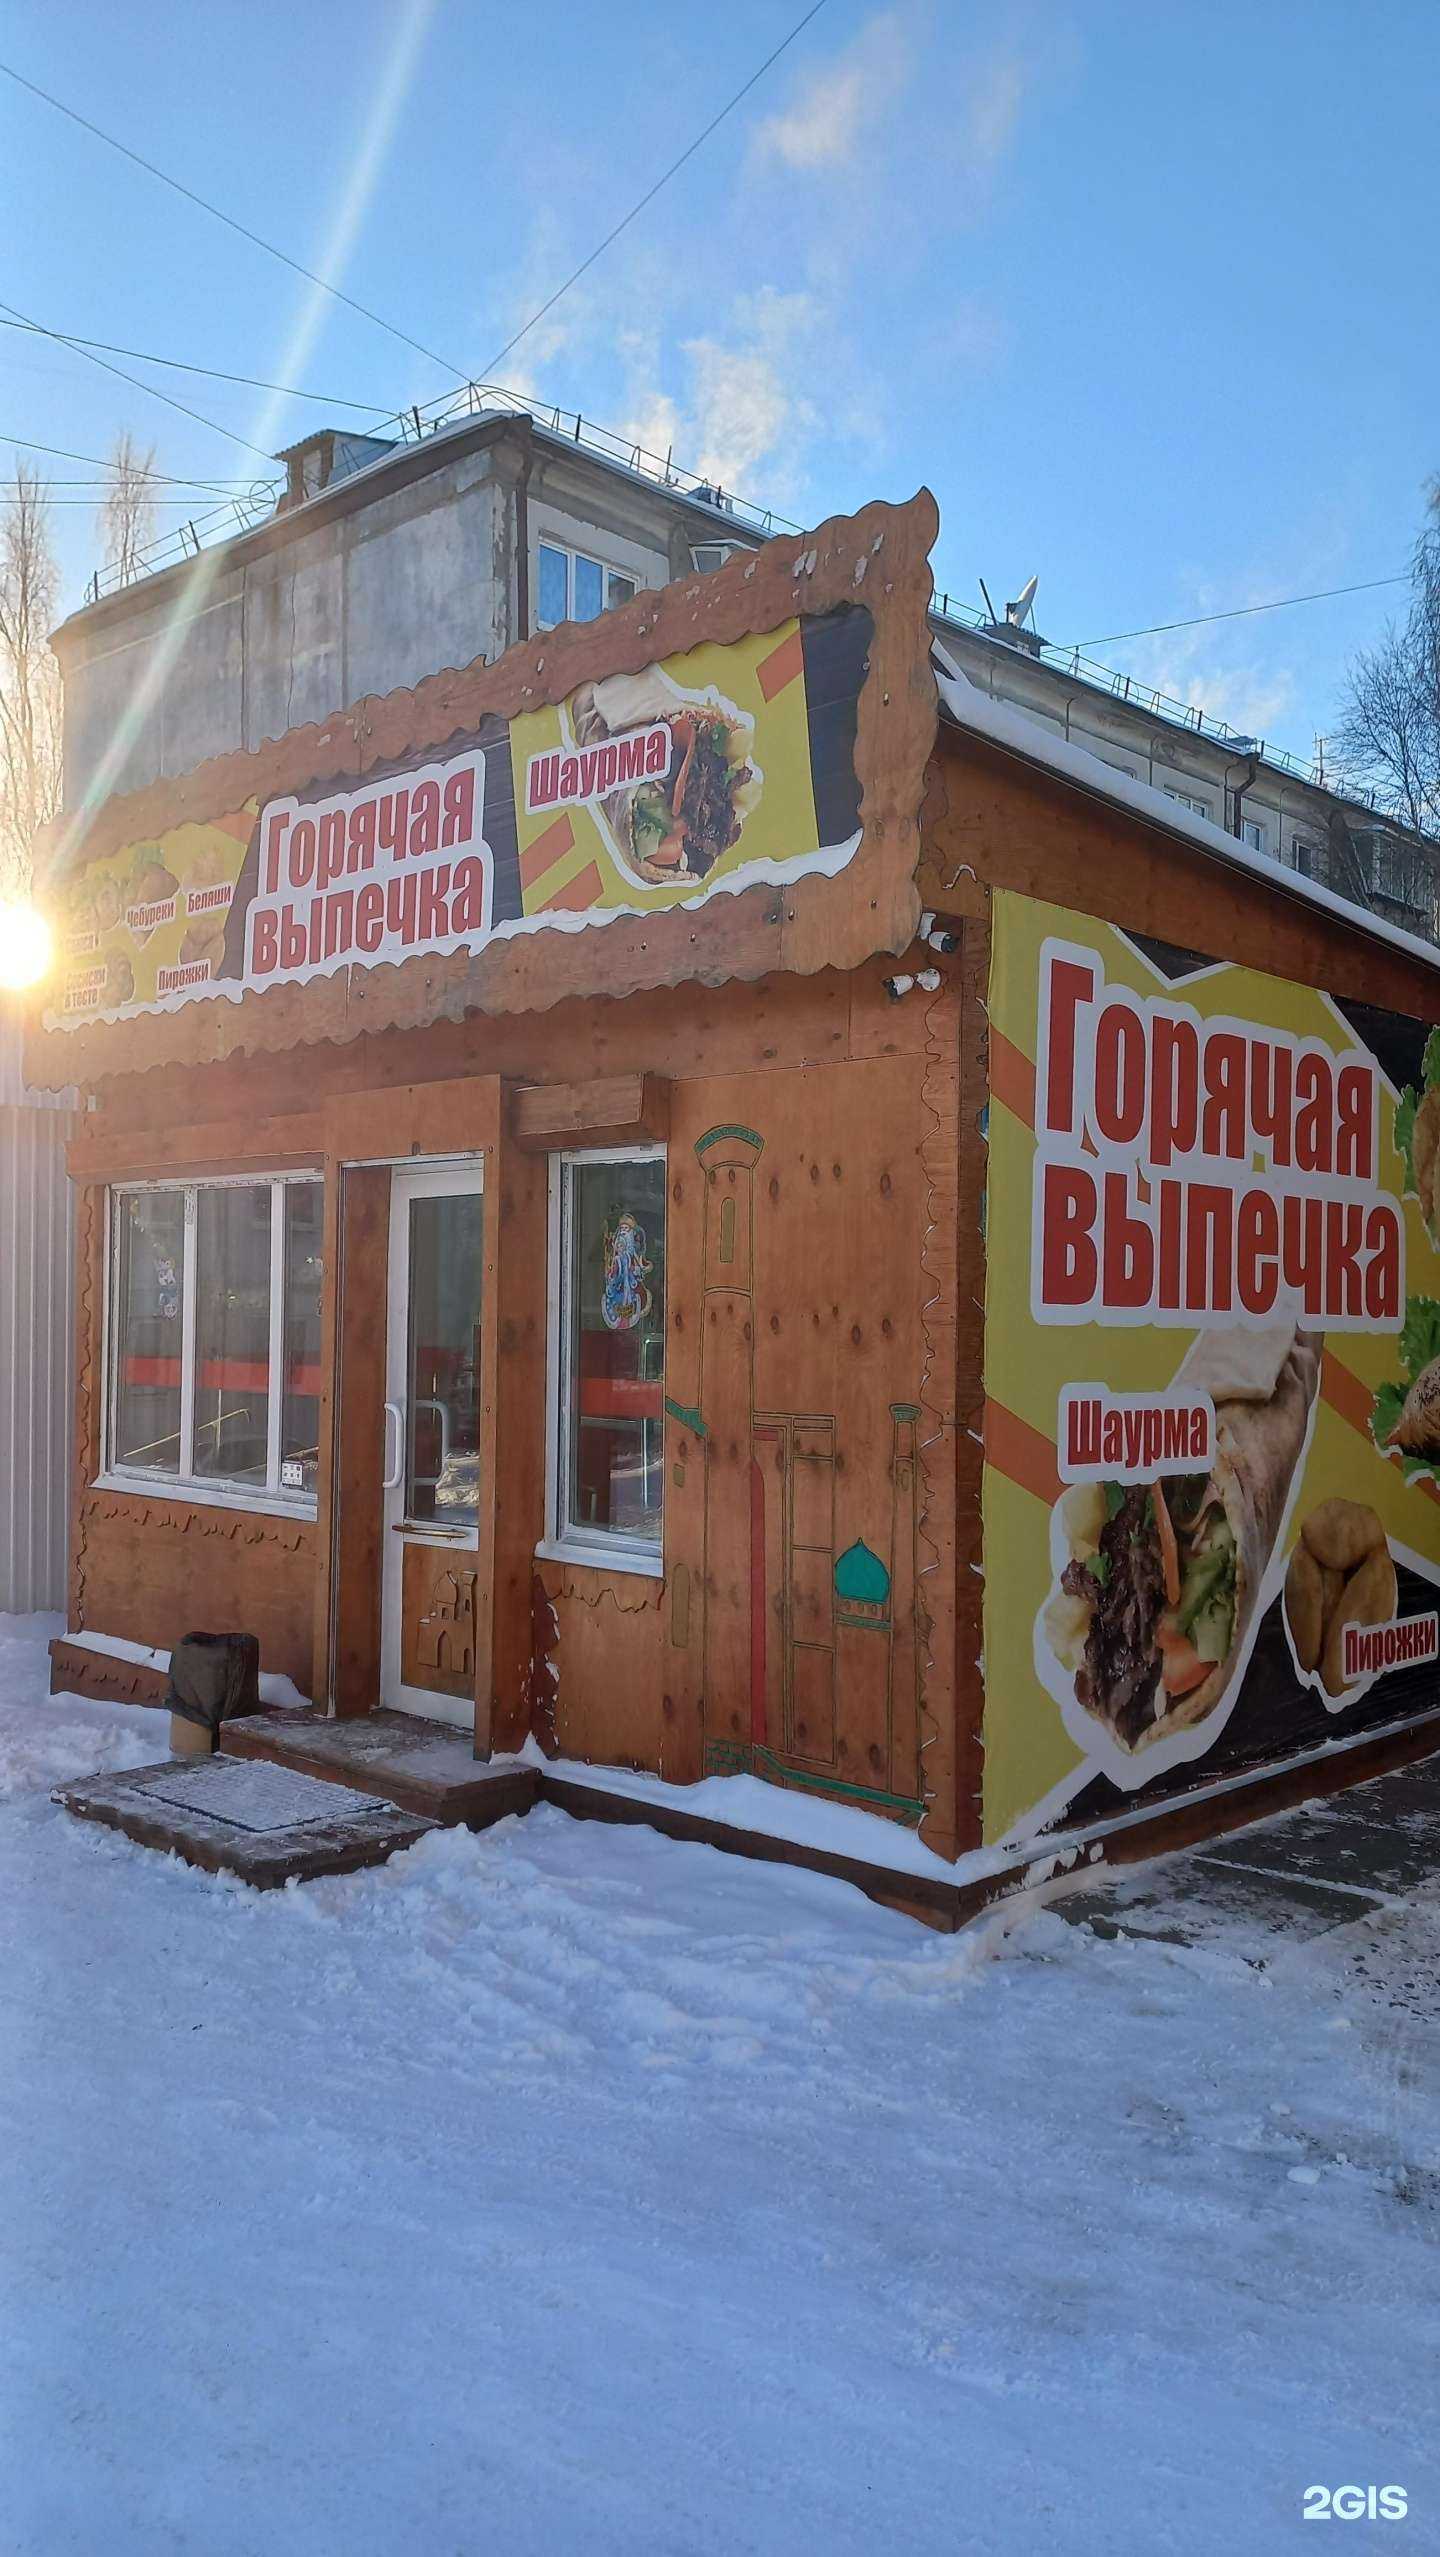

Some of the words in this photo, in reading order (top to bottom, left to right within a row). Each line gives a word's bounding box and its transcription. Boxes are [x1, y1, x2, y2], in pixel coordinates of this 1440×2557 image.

[530, 729, 666, 808] Шаурма
[266, 767, 476, 895] Горячая
[127, 901, 175, 928] Чебуреки
[187, 885, 232, 913] Беляши
[251, 855, 485, 976] выпечка
[158, 963, 209, 990] Пирожки
[1046, 958, 1373, 1179] Горячая
[1042, 1163, 1400, 1320] выпечка
[1066, 1400, 1209, 1468] Шаурма
[1345, 1619, 1436, 1675] Пирожки
